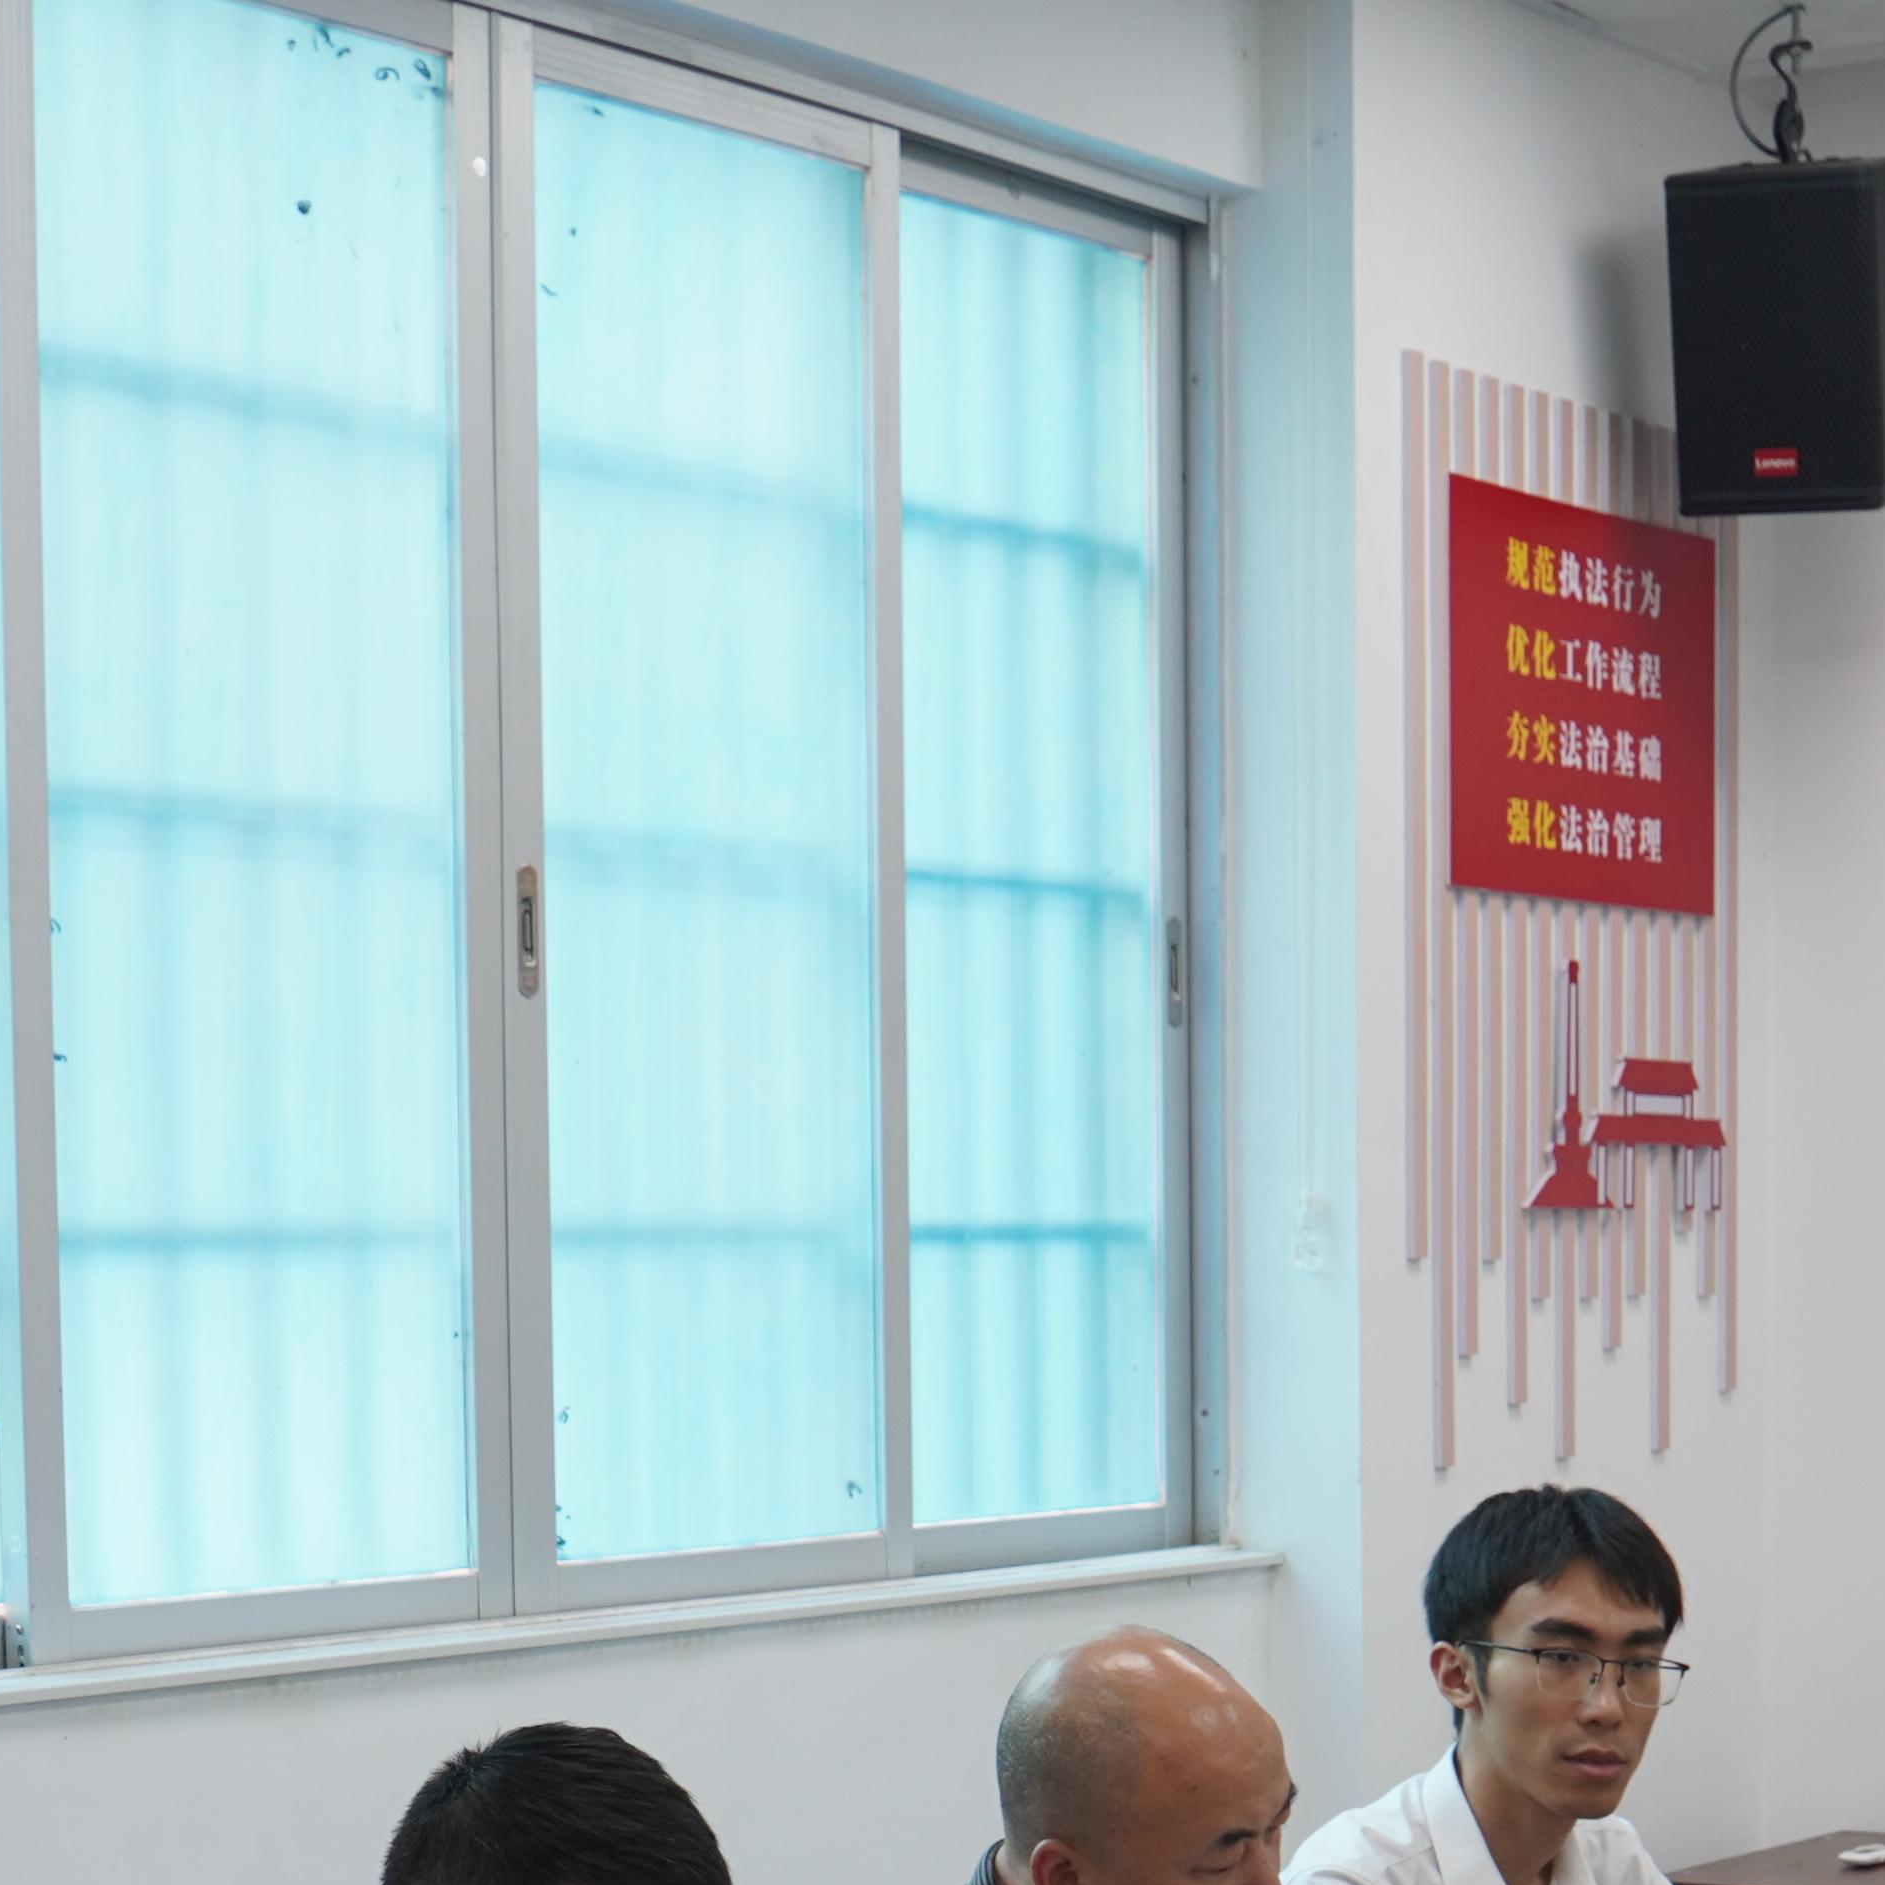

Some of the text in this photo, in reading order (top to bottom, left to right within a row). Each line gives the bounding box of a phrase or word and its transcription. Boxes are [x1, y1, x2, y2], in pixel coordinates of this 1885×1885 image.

[1506, 536, 1661, 619] 规范执法行为
[1506, 623, 1662, 700] 优化工作流程
[1506, 709, 1661, 783] 夯实法治基础
[1506, 797, 1662, 863] 强化法治管理
